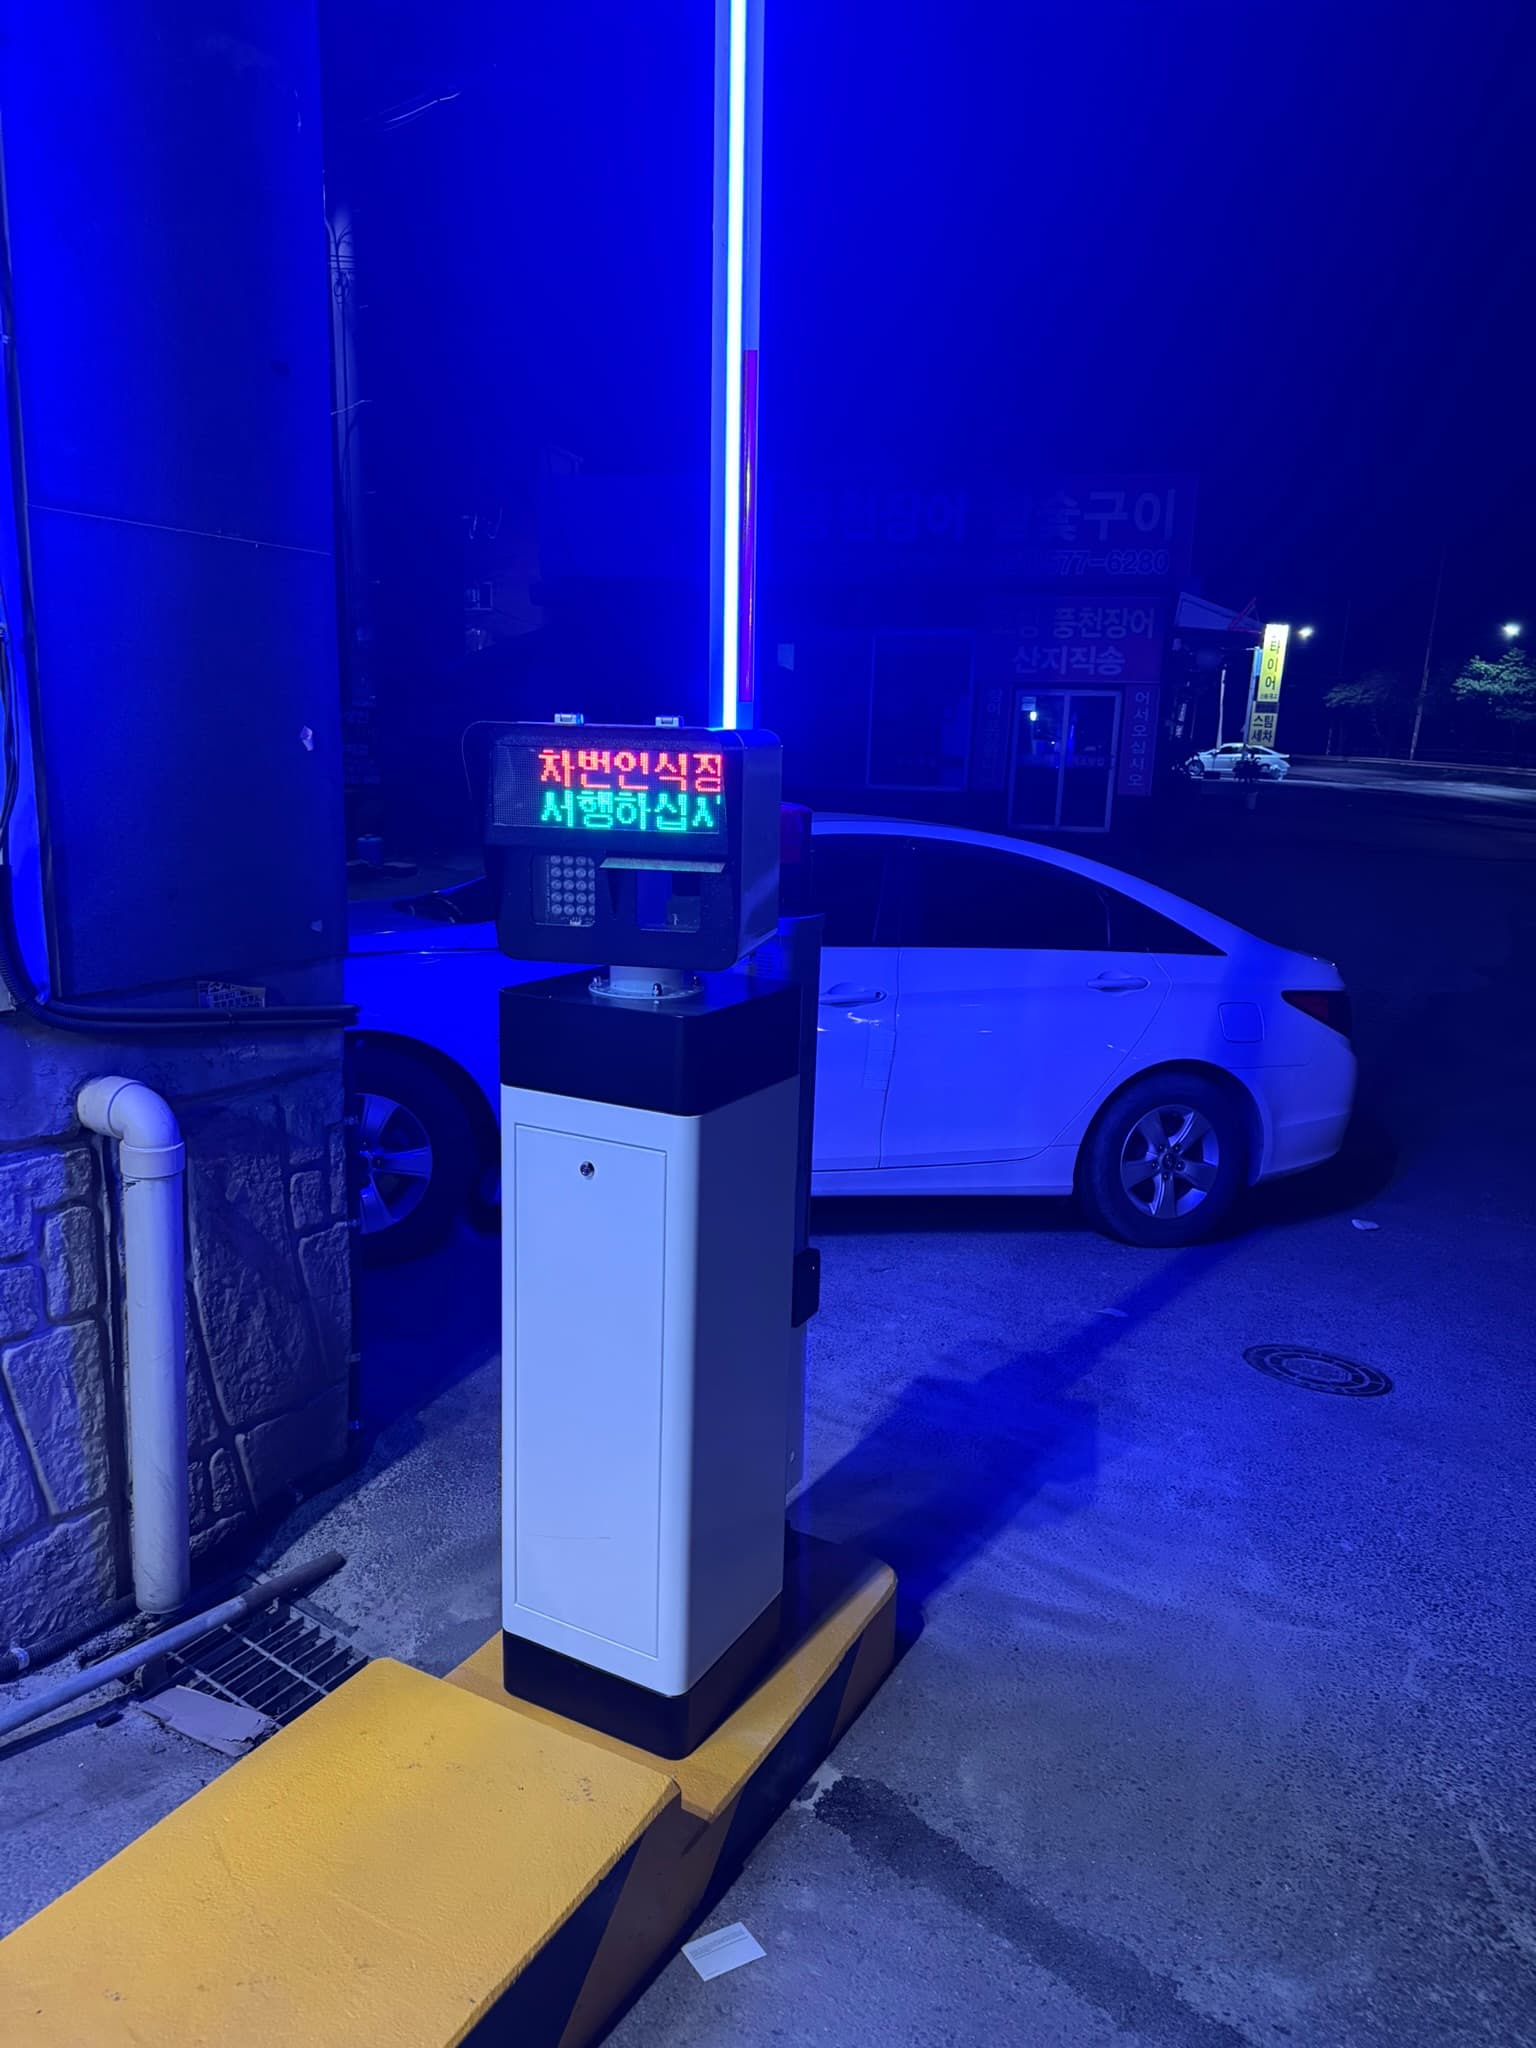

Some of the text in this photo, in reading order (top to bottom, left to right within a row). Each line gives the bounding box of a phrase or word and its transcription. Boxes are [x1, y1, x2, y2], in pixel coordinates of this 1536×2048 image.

[1013, 645, 1126, 677] 산지직송
[1252, 715, 1274, 729] 스팀
[1127, 690, 1152, 787] 어서오십시오
[1250, 730, 1273, 743] 세차
